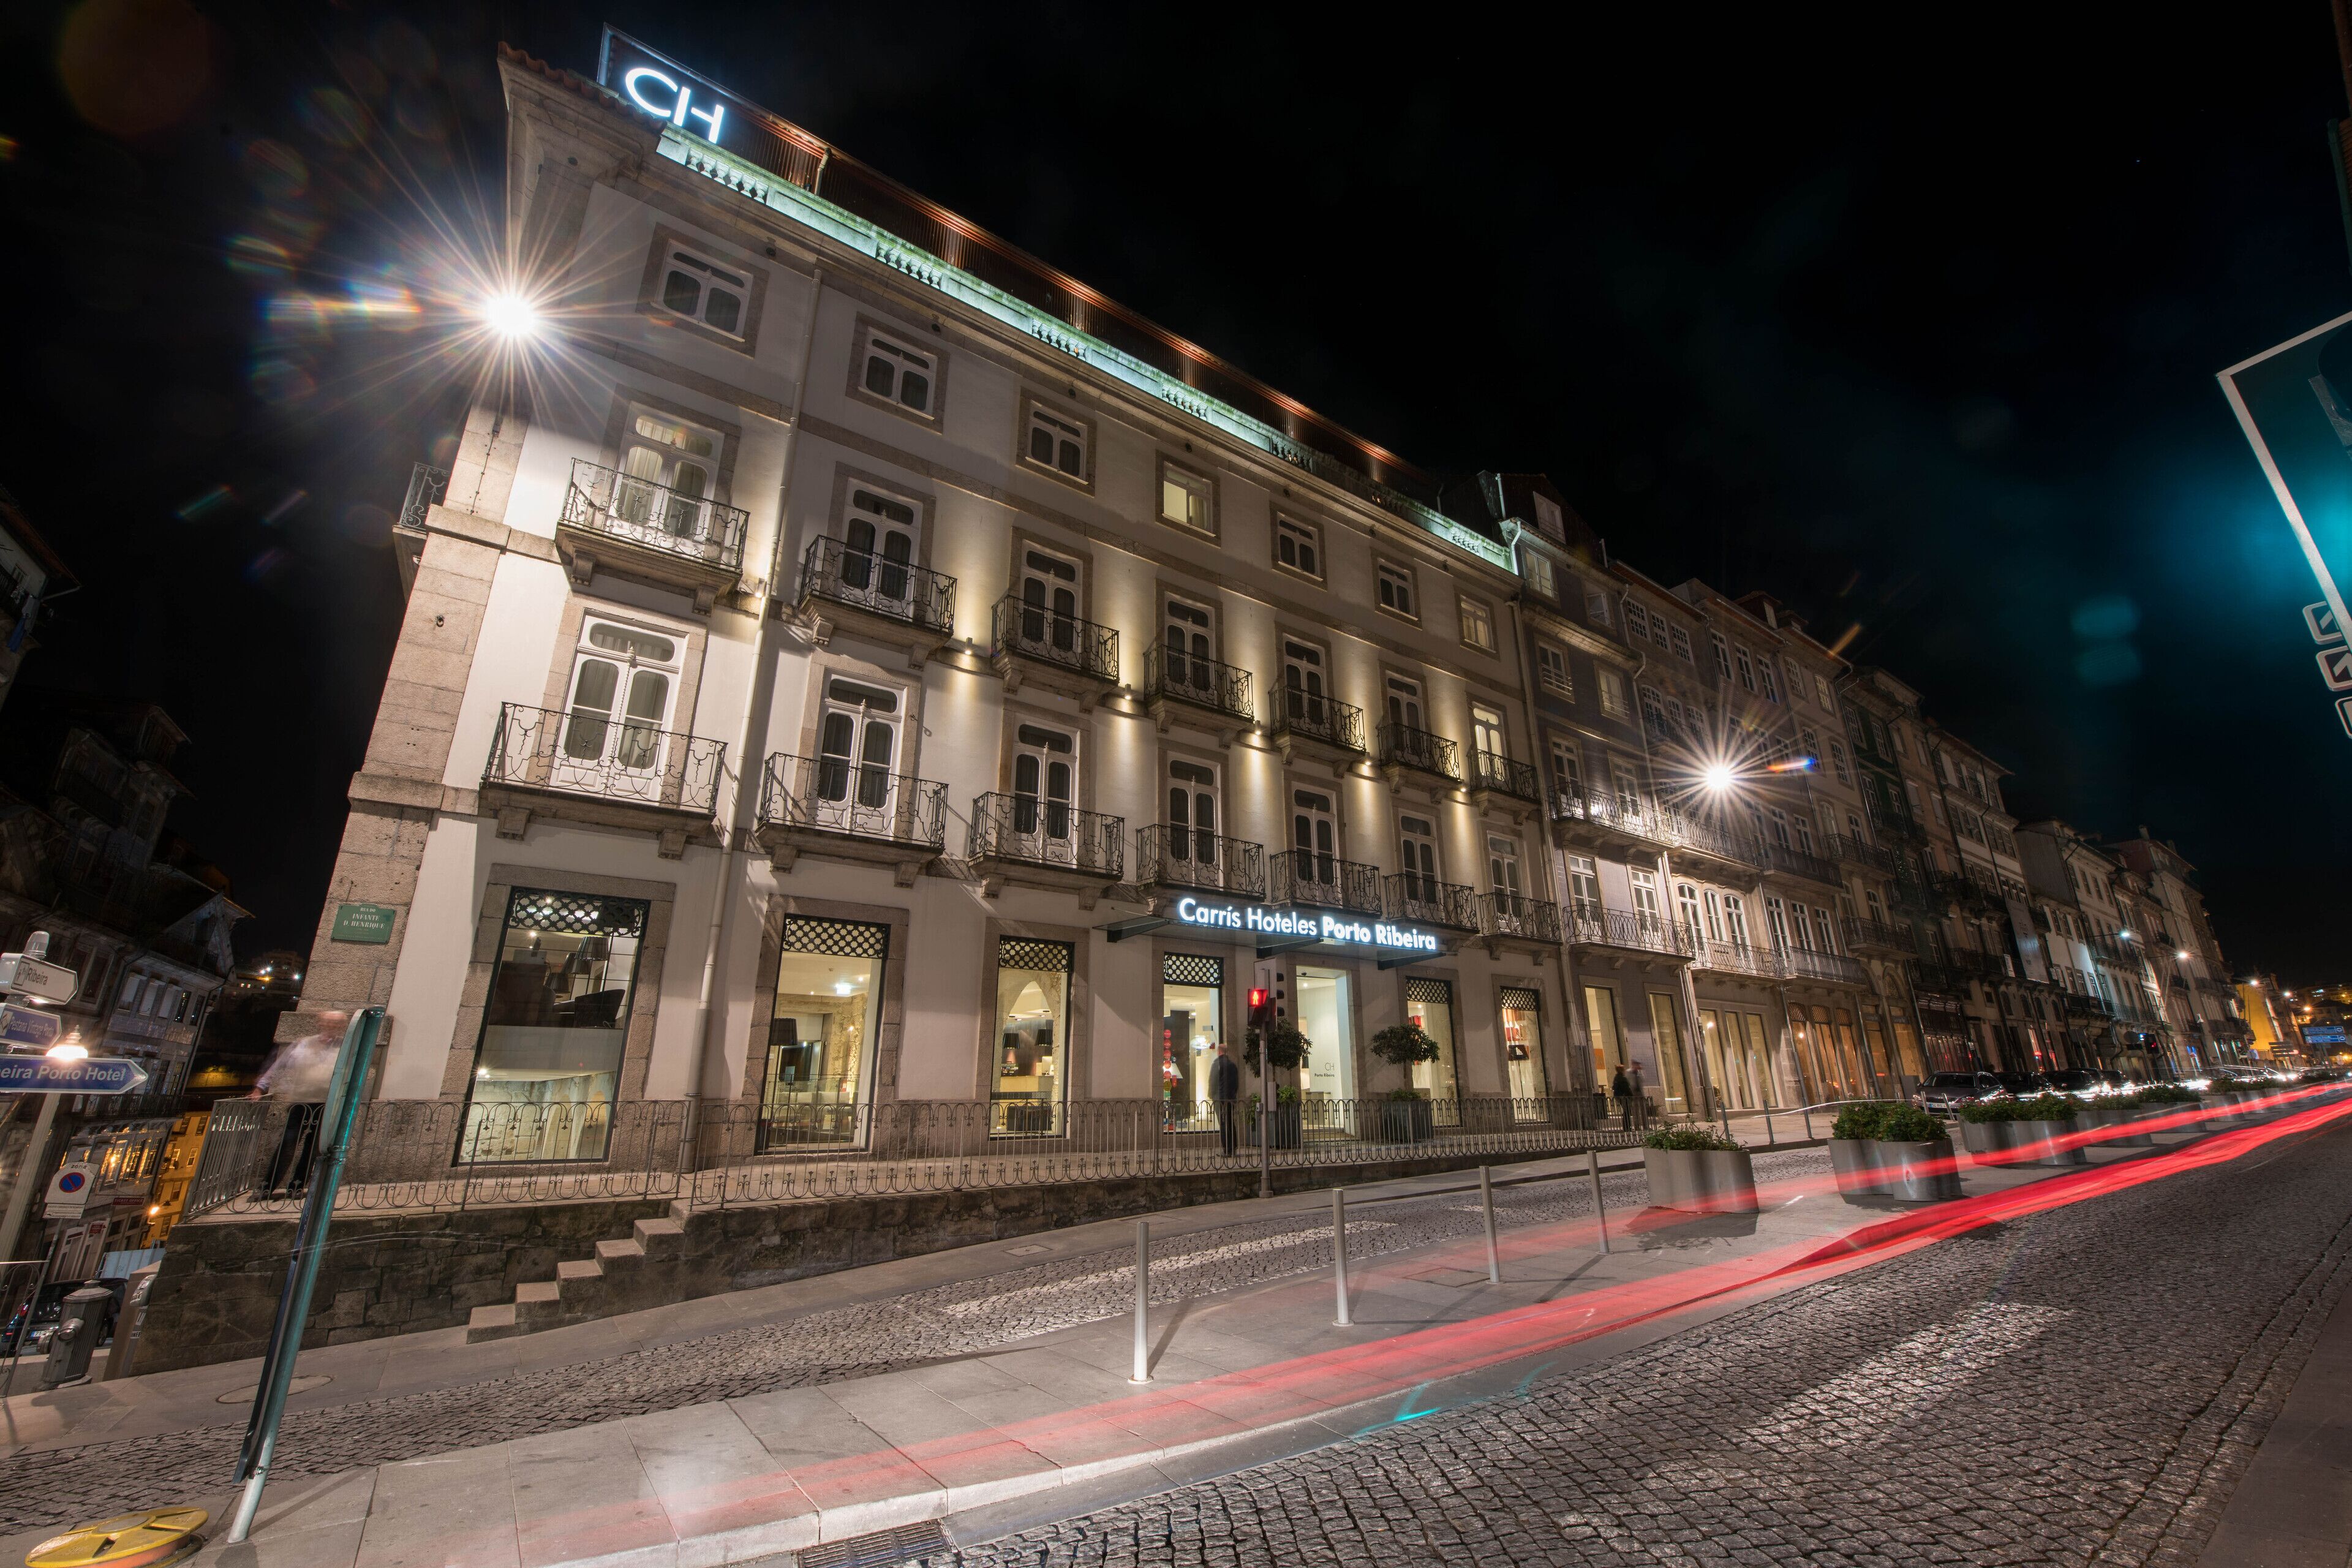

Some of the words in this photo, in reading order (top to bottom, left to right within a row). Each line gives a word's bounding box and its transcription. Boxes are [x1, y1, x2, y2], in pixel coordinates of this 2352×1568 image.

[625, 67, 725, 144] CH
[351, 921, 385, 929] HENRIQUE
[1179, 898, 1241, 928] Carrís
[1248, 907, 1317, 936] Hoteles
[1322, 916, 1371, 943] Porto
[1375, 924, 1436, 950] Ribeira
[26, 968, 48, 986] Ribeira
[0, 1065, 33, 1079] eira
[37, 1066, 81, 1080] Porto
[85, 1068, 126, 1081] Hotel
